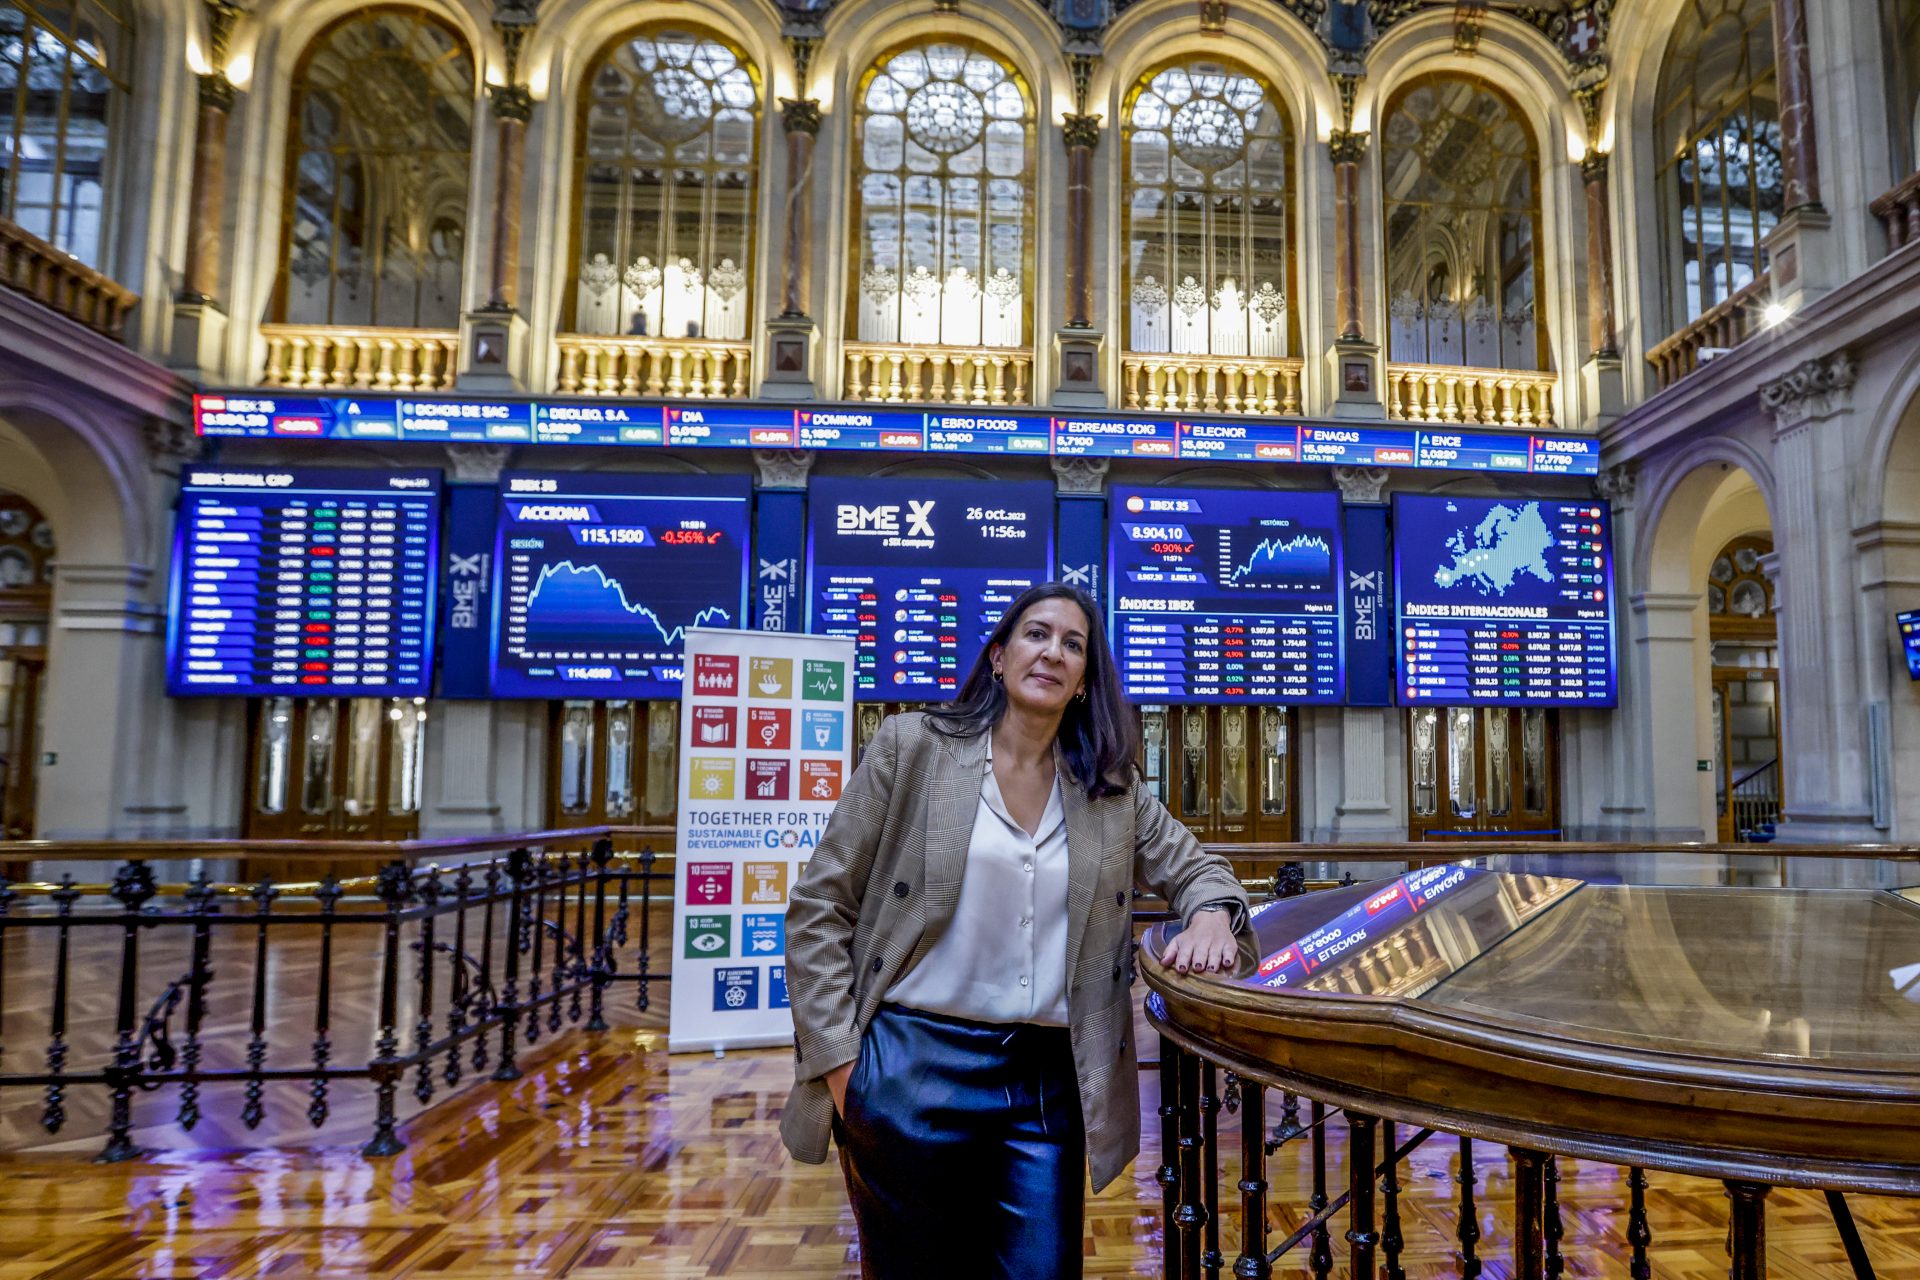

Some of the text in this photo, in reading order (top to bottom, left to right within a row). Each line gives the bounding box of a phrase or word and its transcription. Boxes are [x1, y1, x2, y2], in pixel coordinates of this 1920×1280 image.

[682, 411, 704, 423] DIA
[812, 415, 873, 426] DOMINION
[941, 418, 1018, 431] EBRO FOODS
[1068, 422, 1156, 435] EDREAMS ODIG
[1193, 425, 1247, 438] ELECNOR
[1313, 430, 1360, 442] ENAGAS
[1431, 436, 1462, 447] ENCE
[1546, 442, 1589, 453] ENDESA
[1150, 500, 1189, 511] IBEX 35
[518, 505, 590, 521] ACCIONA
[837, 504, 900, 530] BME
[967, 507, 983, 520] 26
[1260, 518, 1290, 526] HISTÓRICO
[580, 528, 704, 544] 115,1500 -0,56%
[981, 525, 1026, 538] 11:56:10
[1132, 527, 1183, 541] 8.904,10
[902, 538, 935, 549] company
[1151, 543, 1182, 554] -0,90%
[789, 559, 797, 583] company
[1091, 564, 1099, 588] company
[451, 580, 474, 628] BME
[763, 585, 783, 631] BME
[1120, 596, 1195, 611] ÍNDICES IBEX
[1304, 604, 1323, 613] Página
[1406, 602, 1548, 618] ÍNDICES INTERNACIONALES
[1578, 610, 1595, 618] Página
[1354, 595, 1372, 640] BME
[698, 657, 703, 667] 1
[753, 660, 758, 669] 2
[807, 662, 812, 672] 3
[696, 708, 702, 718] 4
[751, 710, 757, 720] 5
[806, 712, 811, 722] 6
[694, 760, 700, 770] 7
[750, 761, 756, 771] 8
[804, 762, 809, 772] 9
[689, 811, 832, 825] TOGETHER FOR TH
[688, 829, 762, 838] SUSTAINABLE
[687, 839, 761, 849] DEVELOPMENT
[691, 865, 700, 875] 10
[747, 865, 755, 875] 11
[689, 918, 698, 929] 13
[746, 917, 755, 927] 14
[718, 971, 726, 981] 17
[773, 968, 782, 979] 16
